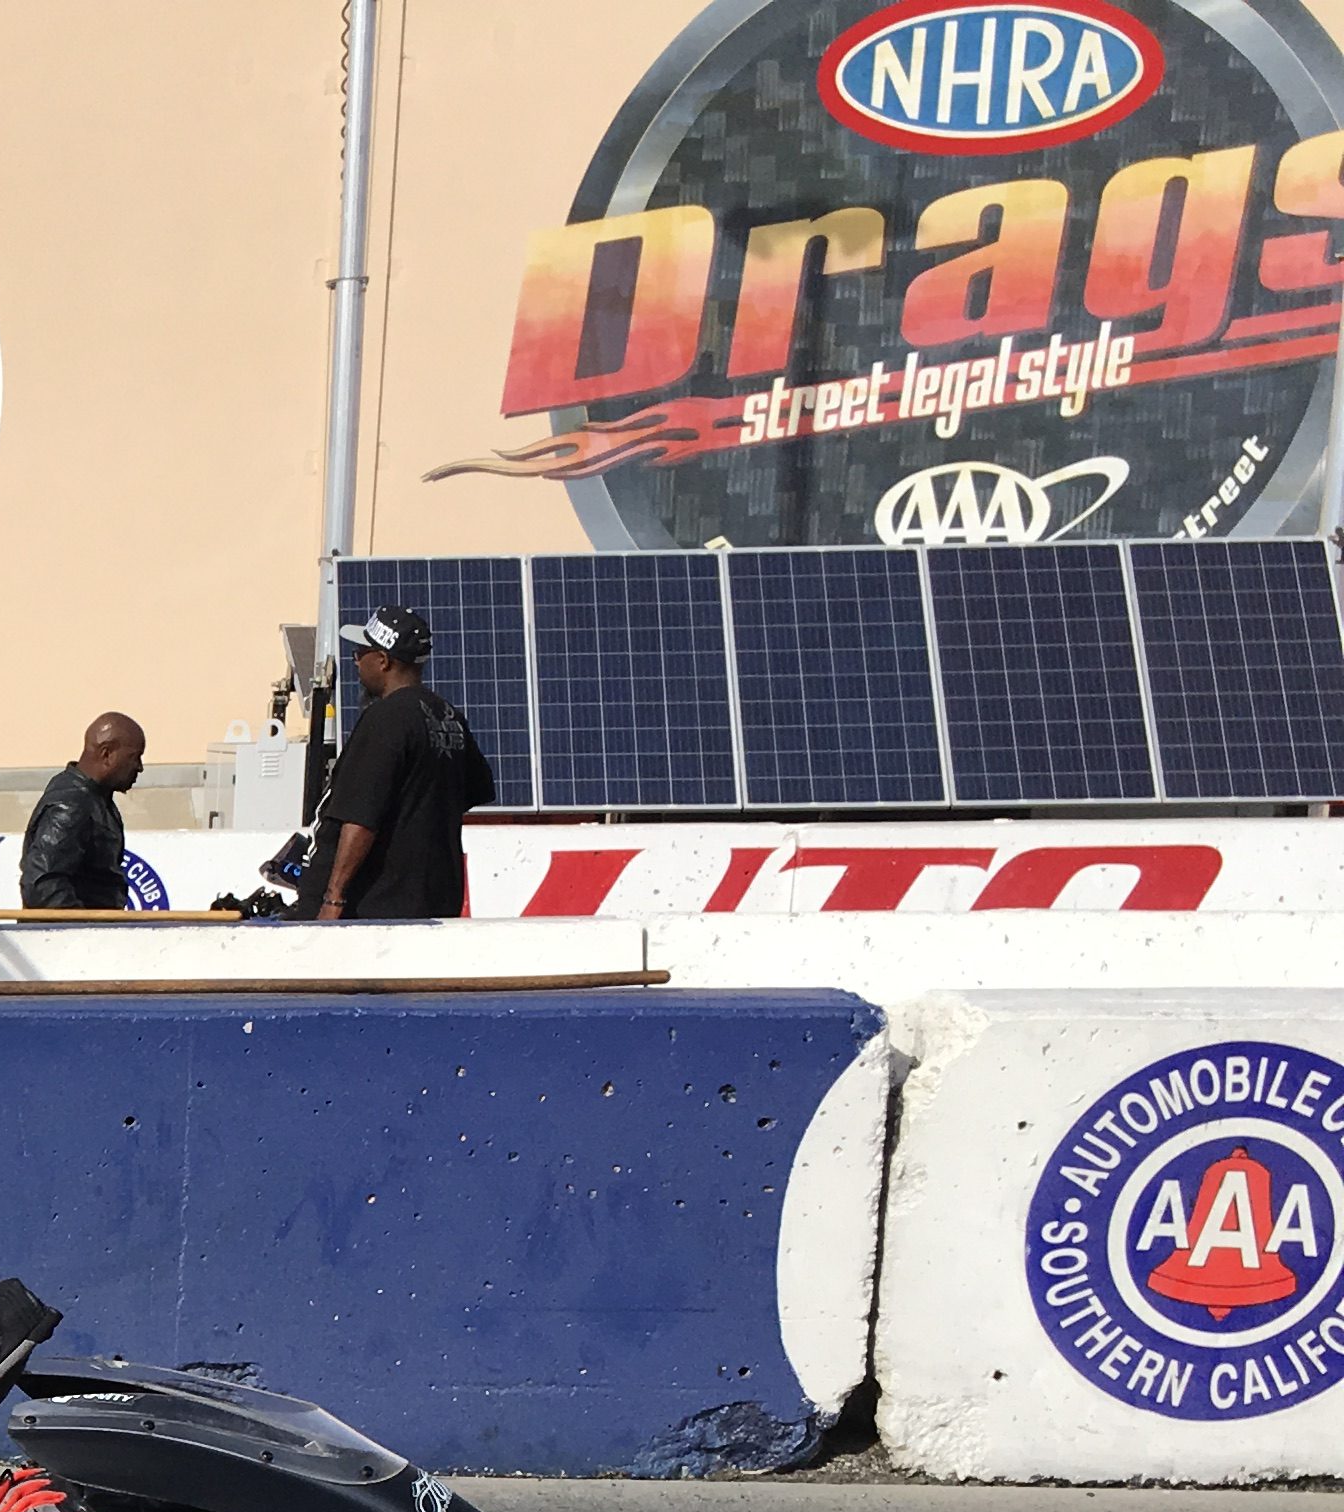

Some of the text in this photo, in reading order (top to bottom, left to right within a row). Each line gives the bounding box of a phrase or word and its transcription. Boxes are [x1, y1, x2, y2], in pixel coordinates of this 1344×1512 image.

[870, 18, 1113, 126] NHRA
[504, 130, 1344, 419] Drags
[740, 321, 1135, 445] street legal style
[896, 467, 1034, 544] AAA
[127, 862, 161, 904] CLUB
[1059, 1055, 1332, 1198] AUTOMOBILE
[1135, 1170, 1318, 1269] AAA
[1040, 1220, 1194, 1408] SOUTHERN
